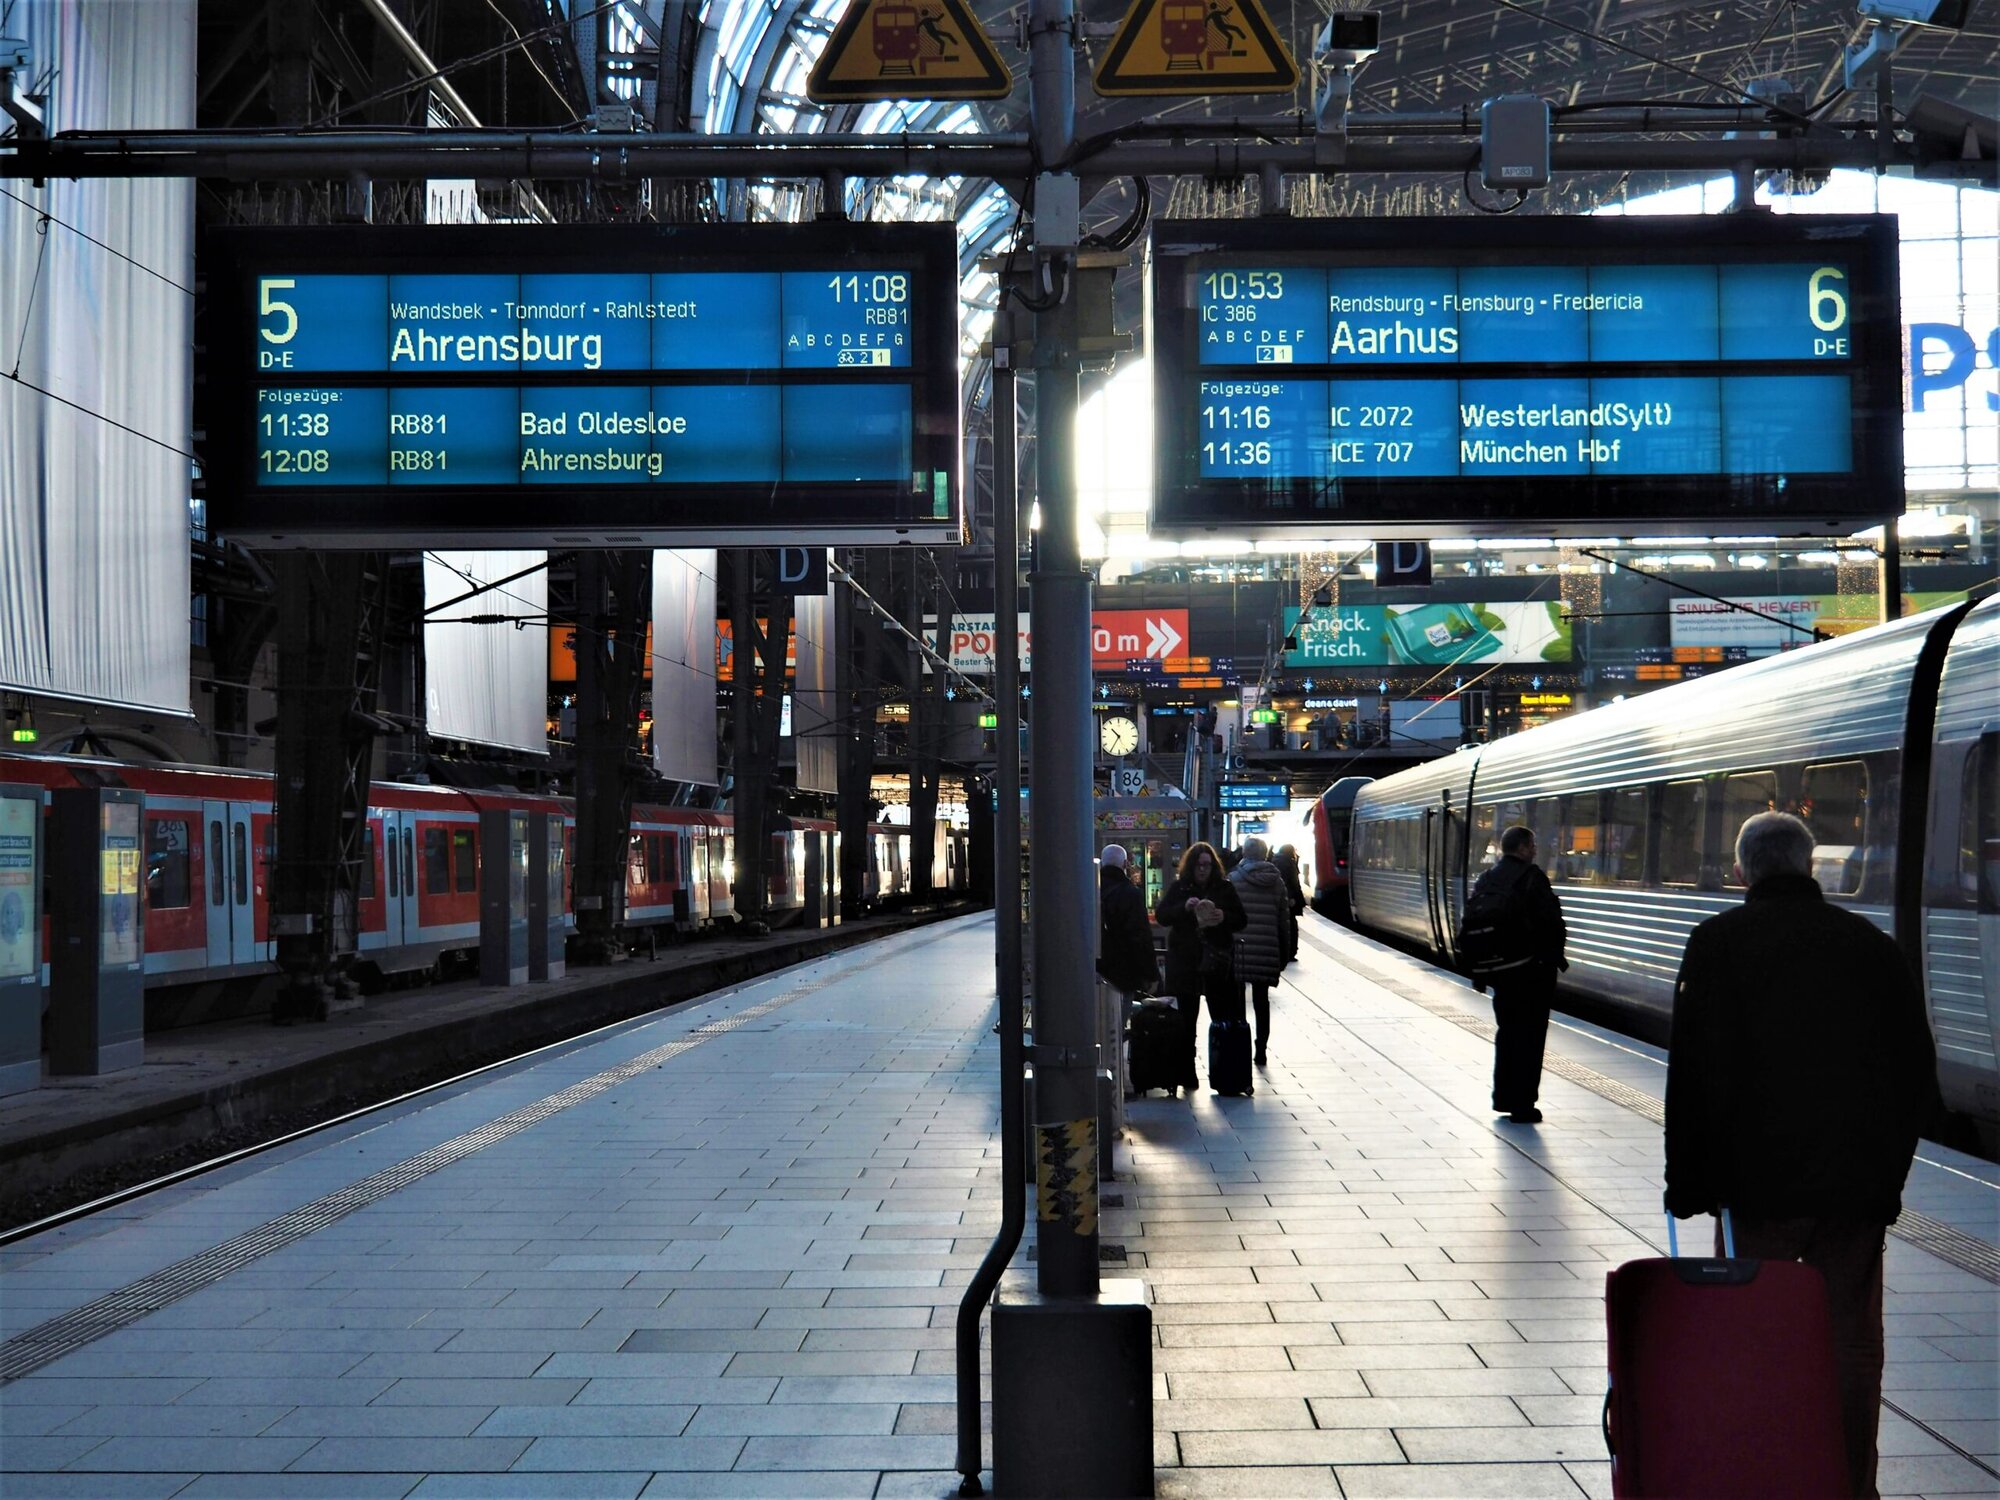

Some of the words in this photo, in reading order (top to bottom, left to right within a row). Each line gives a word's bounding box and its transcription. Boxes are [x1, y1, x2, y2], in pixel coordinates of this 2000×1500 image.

[828, 275, 907, 303] 11:08
[1204, 271, 1283, 300] 10:53
[1330, 295, 1424, 317] Rendsburg
[1443, 294, 1534, 316] Flensburg
[1553, 293, 1643, 311] Fredericia
[1807, 267, 1847, 332] 6
[260, 279, 298, 344] 5
[391, 302, 484, 320] Wandsbek
[504, 302, 586, 320] Tonndorf
[606, 301, 697, 319] Rahlstedt
[865, 307, 907, 325] RB81
[1203, 305, 1219, 322] IC
[1224, 304, 1257, 322] 386
[788, 334, 800, 347] A
[806, 334, 816, 347] B
[824, 333, 833, 346] C
[841, 333, 852, 346] D
[859, 333, 868, 346] E
[876, 333, 885, 346] F
[894, 333, 903, 346] G
[1207, 330, 1219, 343] A
[1226, 330, 1235, 343] B
[1243, 330, 1253, 343] C
[1261, 330, 1271, 343] D
[1278, 329, 1288, 342] E
[1296, 329, 1305, 342] F
[1330, 320, 1458, 355] Aarhus
[391, 327, 602, 370] Ahrensburg
[1262, 348, 1272, 361] 2
[1814, 338, 1847, 356] D-E
[260, 351, 294, 368] D-E
[859, 351, 868, 364] 2
[259, 389, 343, 405] Folgezüge:
[1200, 381, 1284, 398] Folgezüge:
[260, 413, 329, 437] 11:38
[390, 414, 446, 435] RB81
[521, 412, 567, 435] Bad
[578, 411, 687, 435] Oldesloe
[1202, 405, 1271, 429] 11:16
[1331, 406, 1351, 427] IC
[1359, 406, 1413, 427] 2072
[1460, 402, 1672, 432] Westerland(Sylt)
[1202, 441, 1271, 465] 11:36
[1331, 441, 1366, 463] ICE
[1373, 442, 1414, 463] 707
[1460, 438, 1567, 464] München
[1578, 438, 1621, 463] Hbf
[260, 449, 329, 473] 12:08
[390, 450, 446, 471] RB81
[521, 447, 663, 476] Ahrensburg
[781, 547, 809, 582] D
[1393, 542, 1423, 573] D
[1758, 601, 1821, 613] HEVERT
[1117, 634, 1139, 652] m
[1303, 637, 1367, 657] Frisch.
[954, 658, 981, 666] Bester
[1234, 755, 1245, 768] C
[1122, 771, 1142, 787] 86
